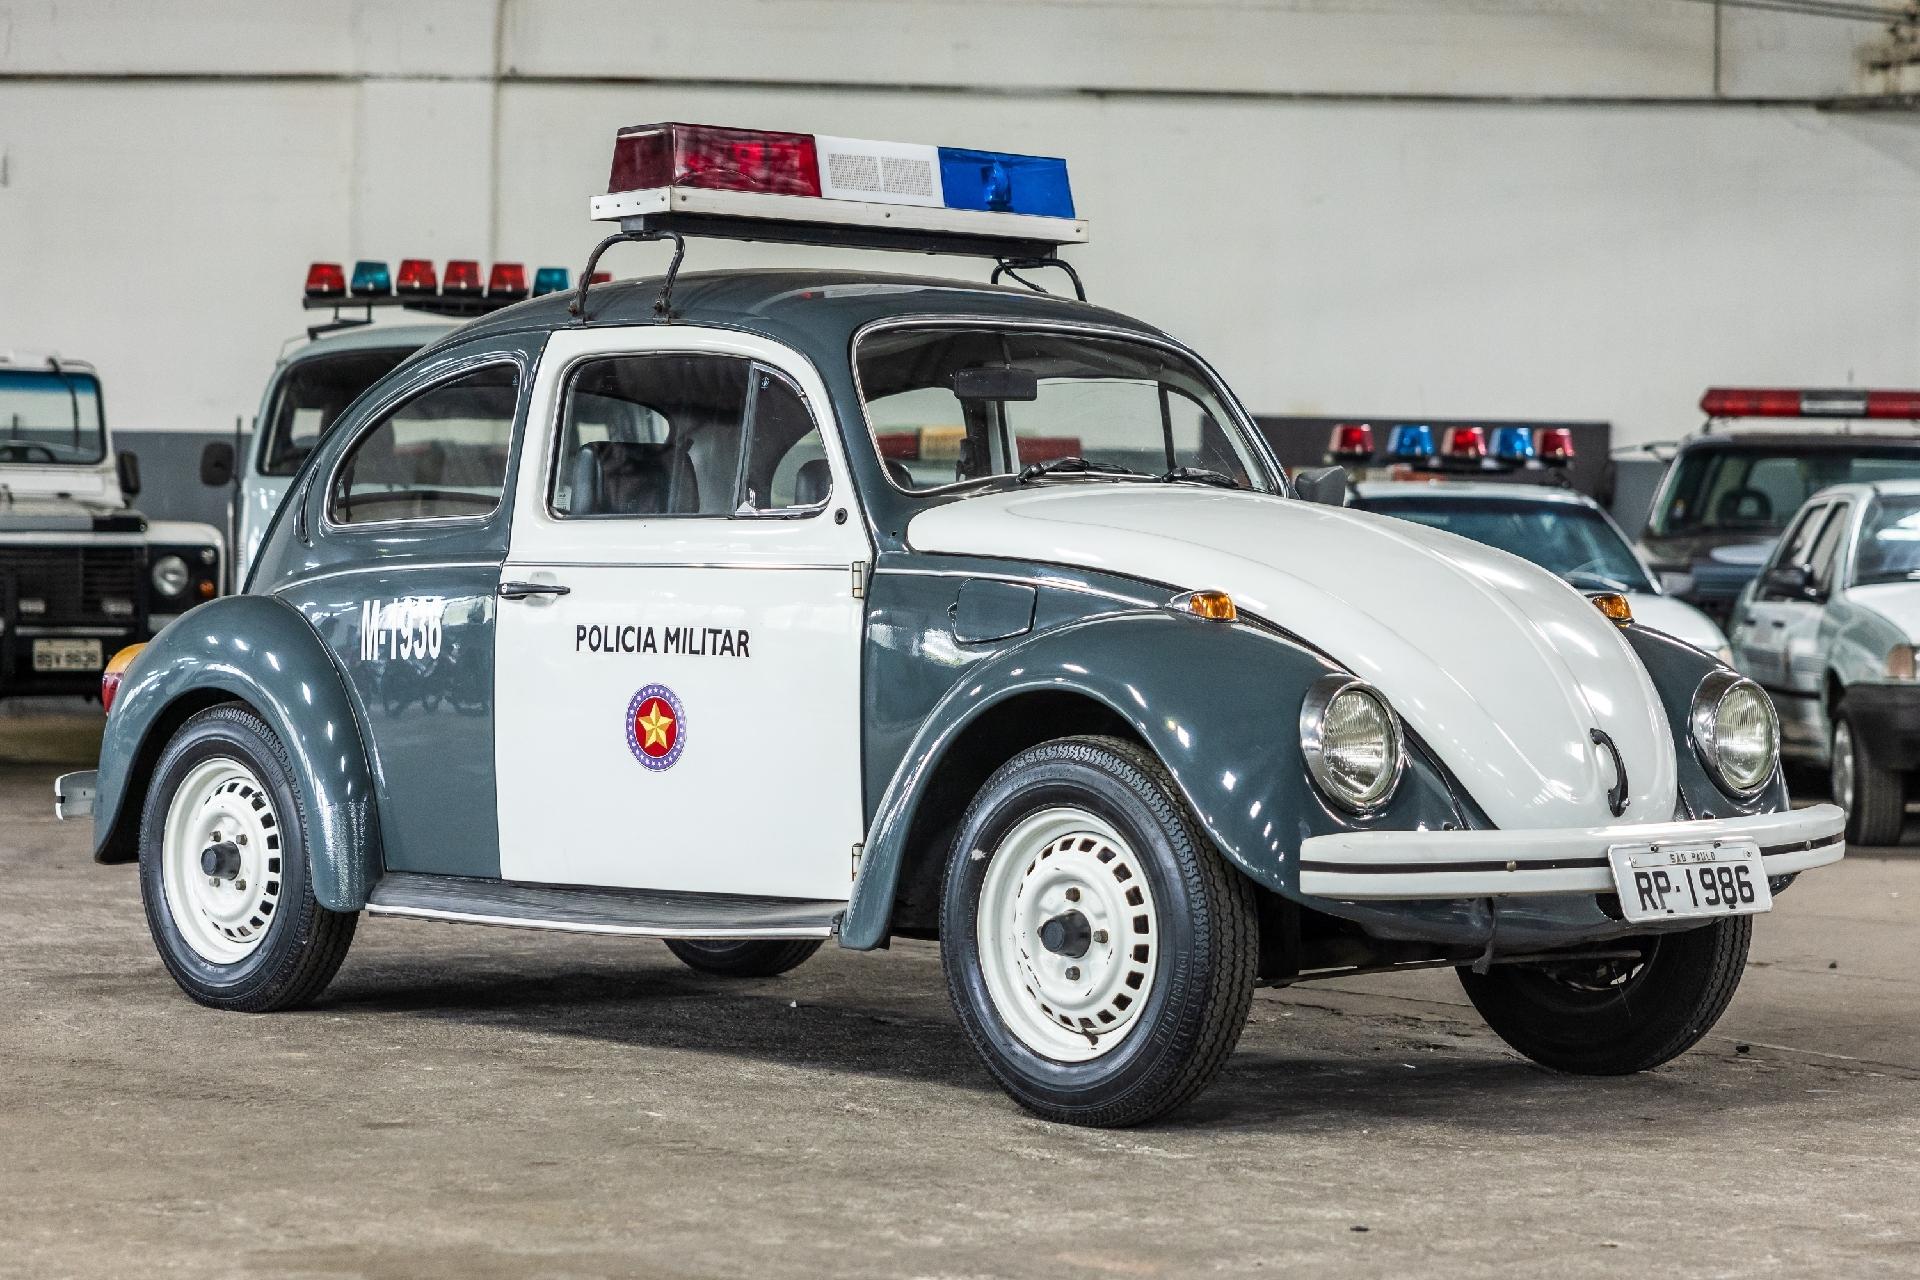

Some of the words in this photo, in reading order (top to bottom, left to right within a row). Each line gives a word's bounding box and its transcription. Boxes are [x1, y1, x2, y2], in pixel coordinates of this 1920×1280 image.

[575, 624, 658, 653] POLICIA
[663, 626, 750, 658] MILITAR
[1691, 850, 1717, 862] PAULO
